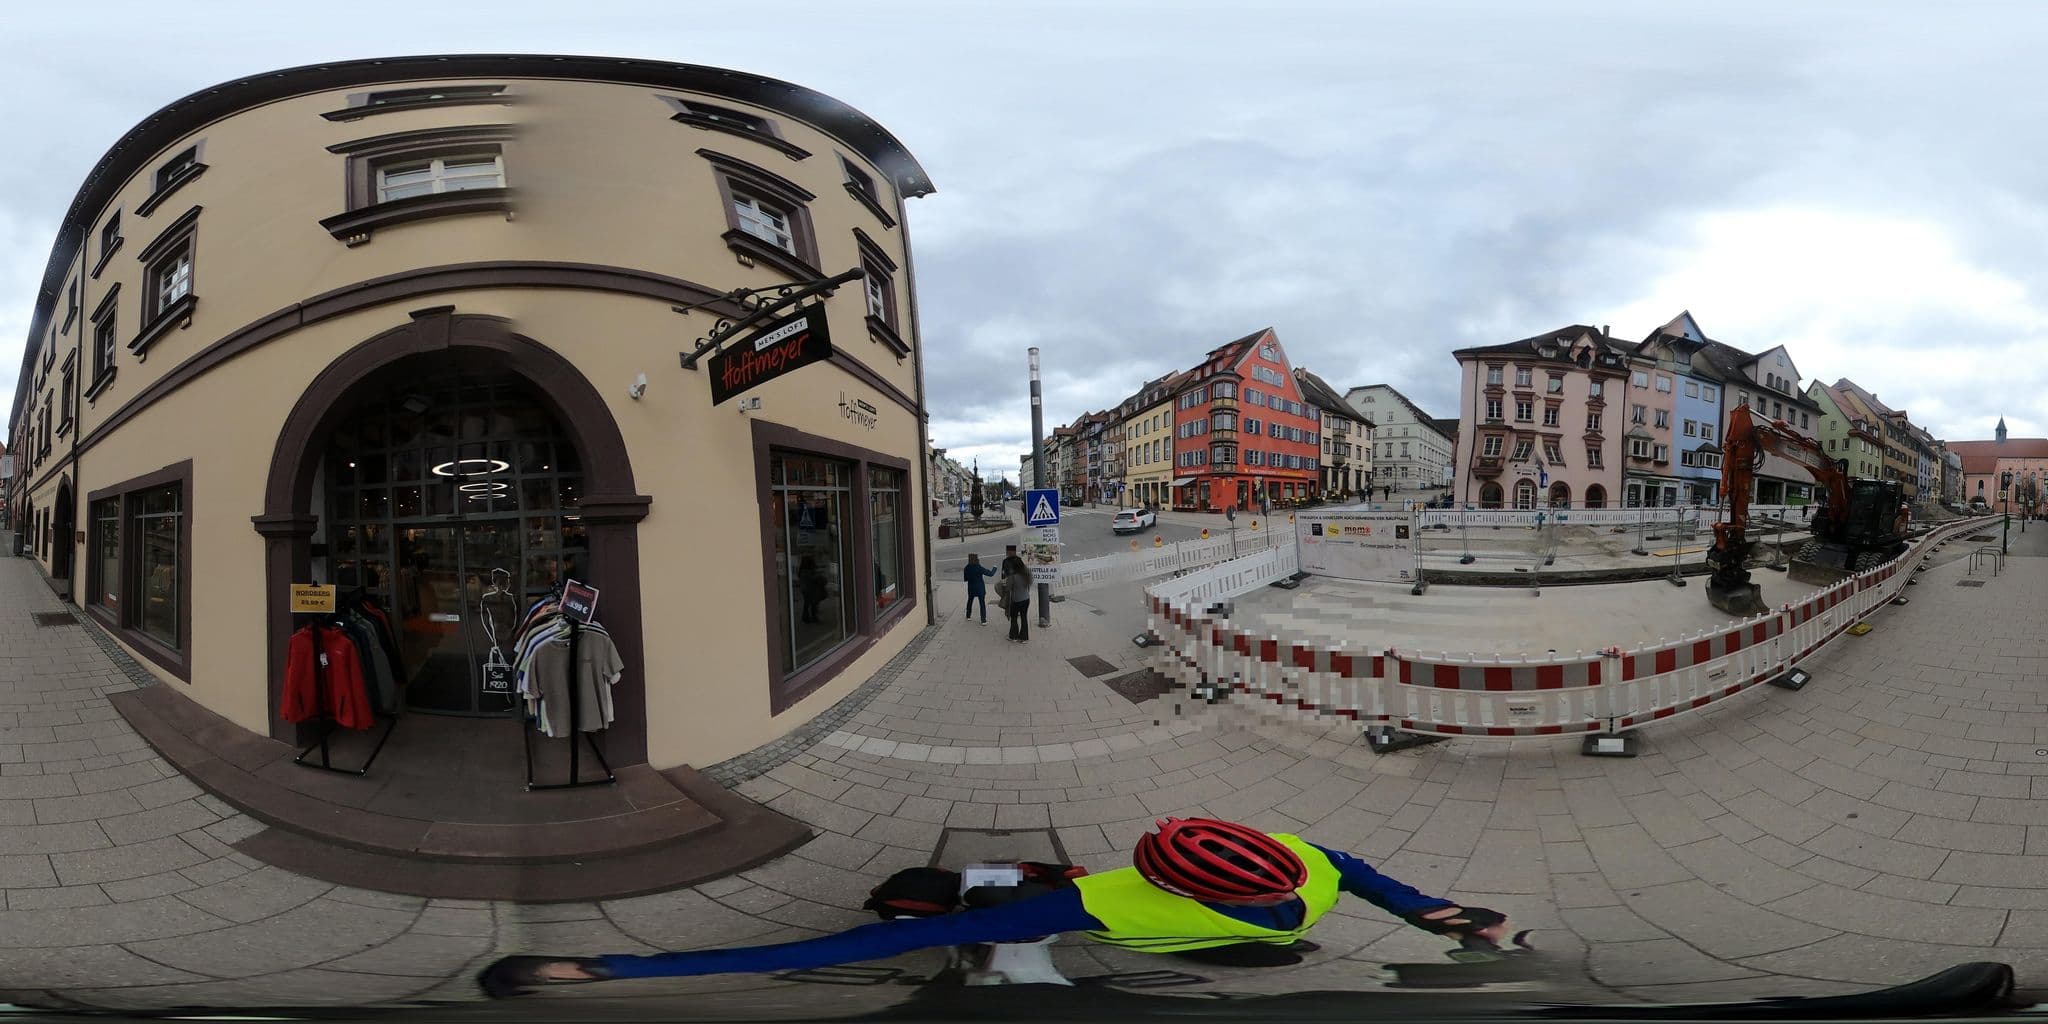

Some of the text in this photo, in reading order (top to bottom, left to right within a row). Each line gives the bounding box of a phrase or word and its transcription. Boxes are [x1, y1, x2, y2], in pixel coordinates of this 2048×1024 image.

[783, 321, 804, 335] LOFT
[721, 332, 810, 390] Hoffmeyer
[839, 391, 878, 432] Hoffmeyer
[489, 680, 508, 689] 1920
